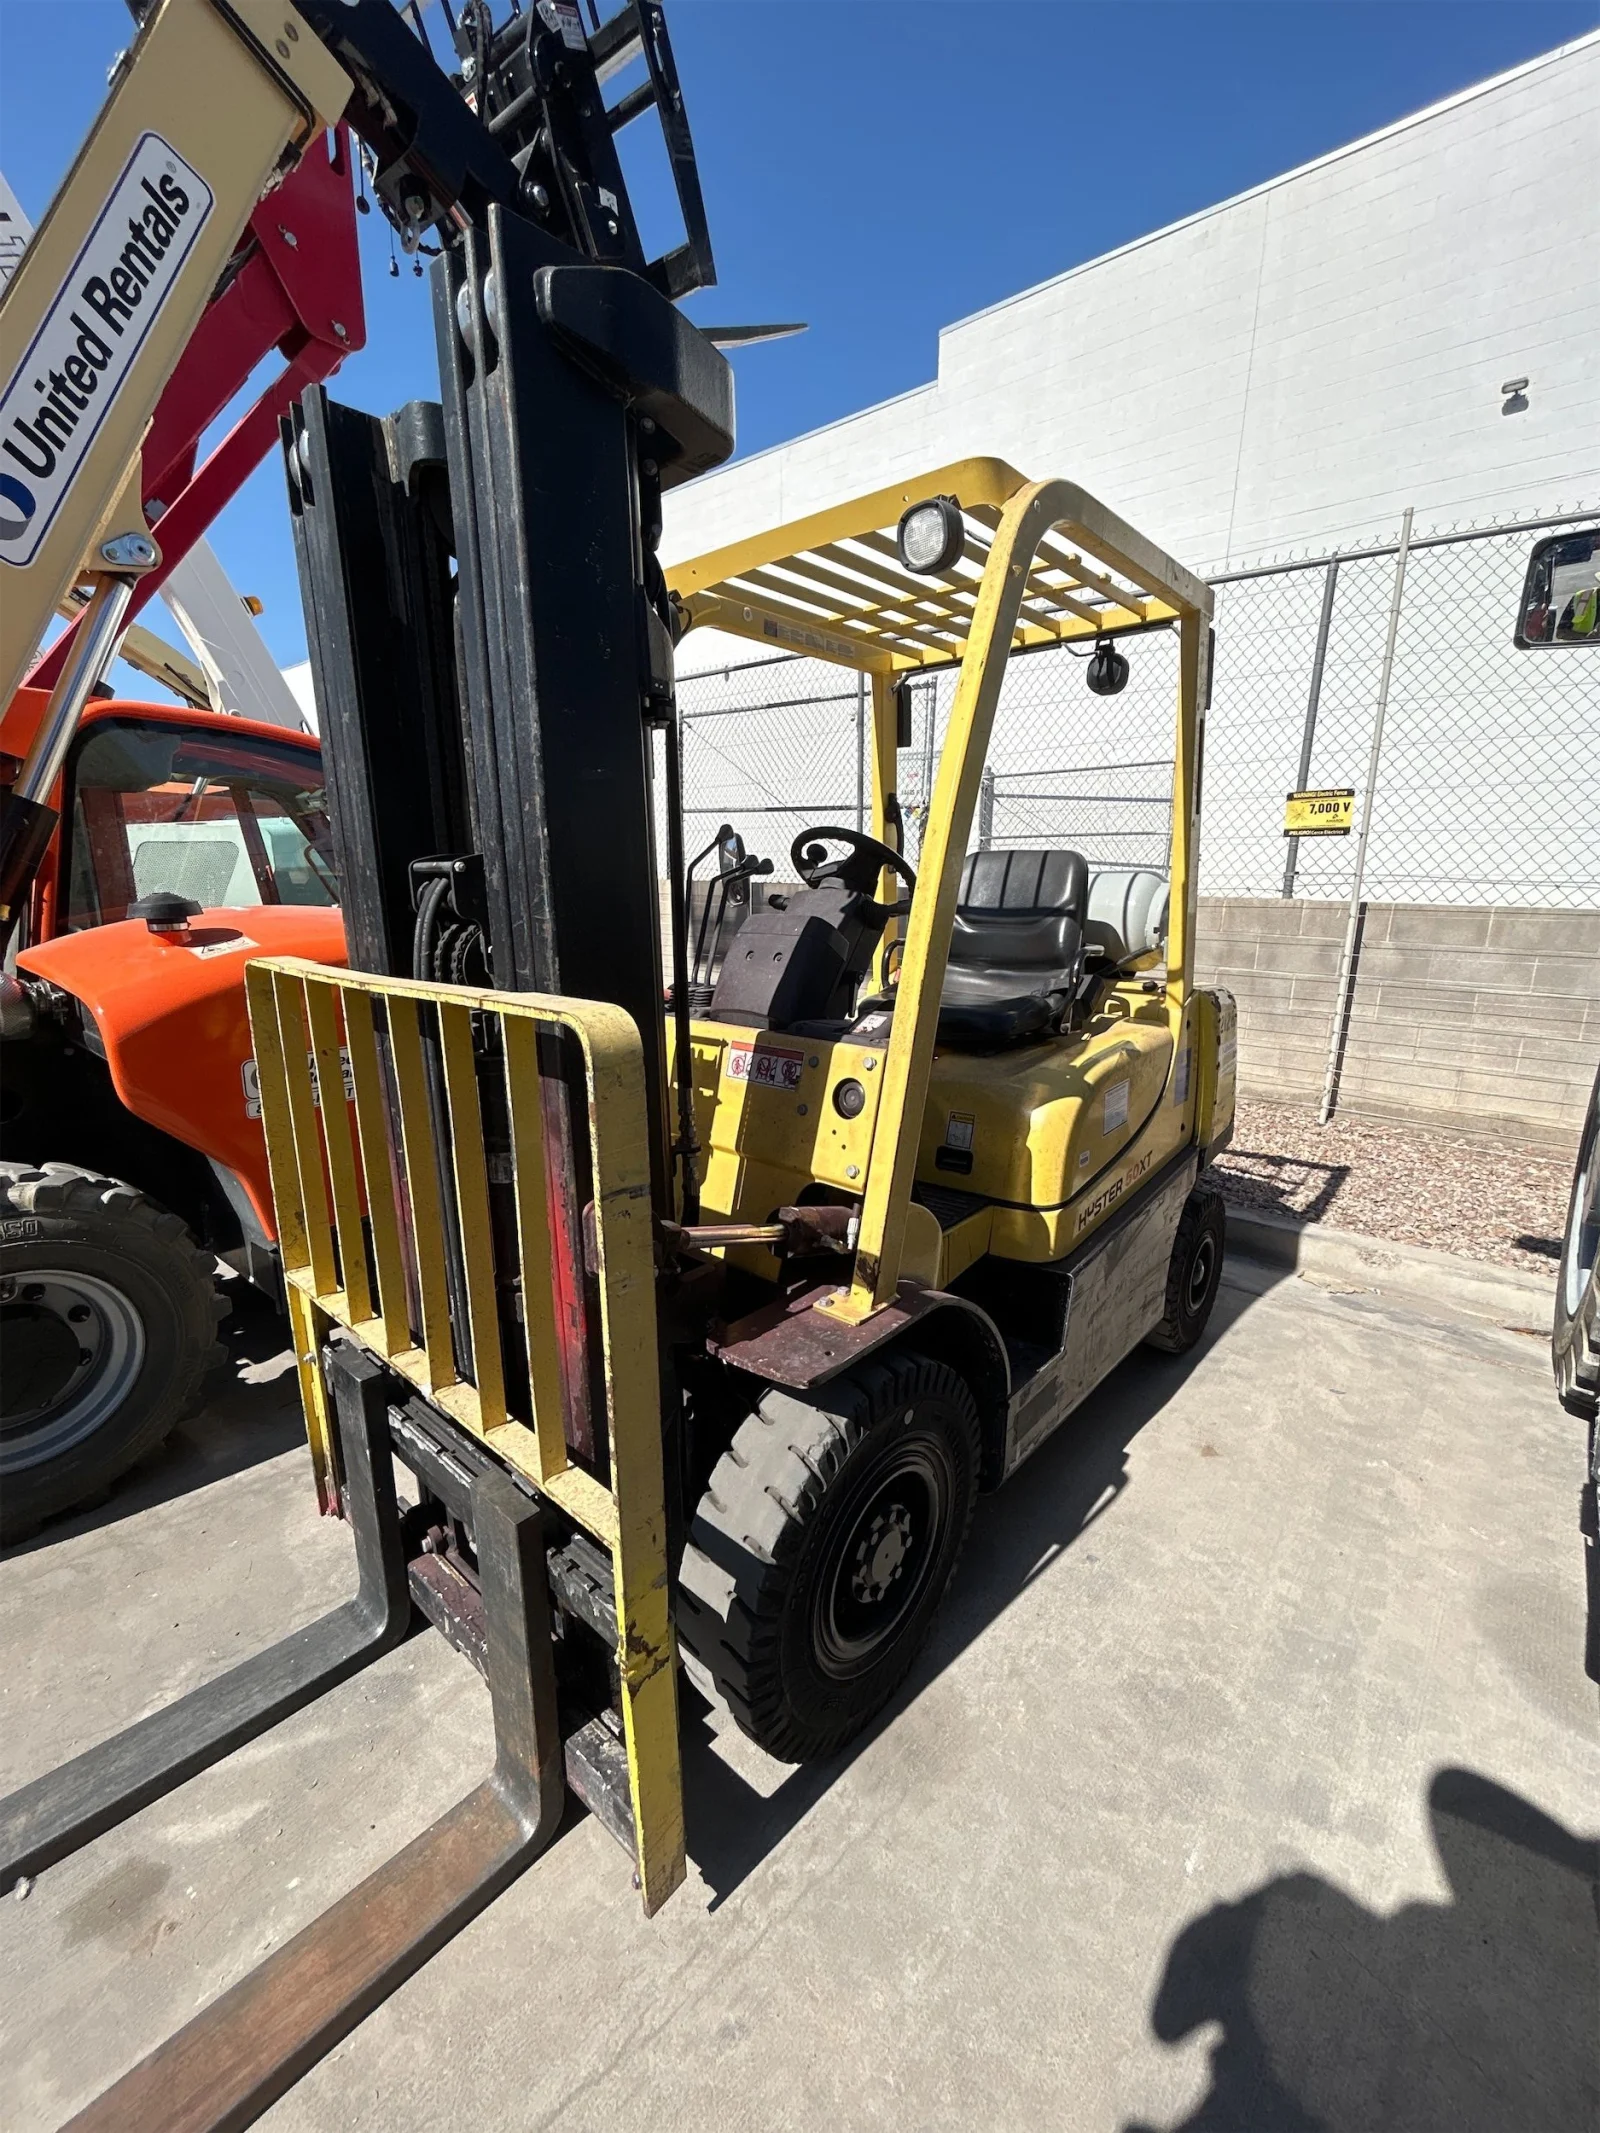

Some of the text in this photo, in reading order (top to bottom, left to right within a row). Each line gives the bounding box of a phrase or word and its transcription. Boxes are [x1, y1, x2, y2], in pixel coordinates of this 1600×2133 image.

[3, 172, 190, 480] United Rentals
[1309, 802, 1350, 815] 7,000 V
[1077, 1150, 1153, 1231] HYSTER 50XT
